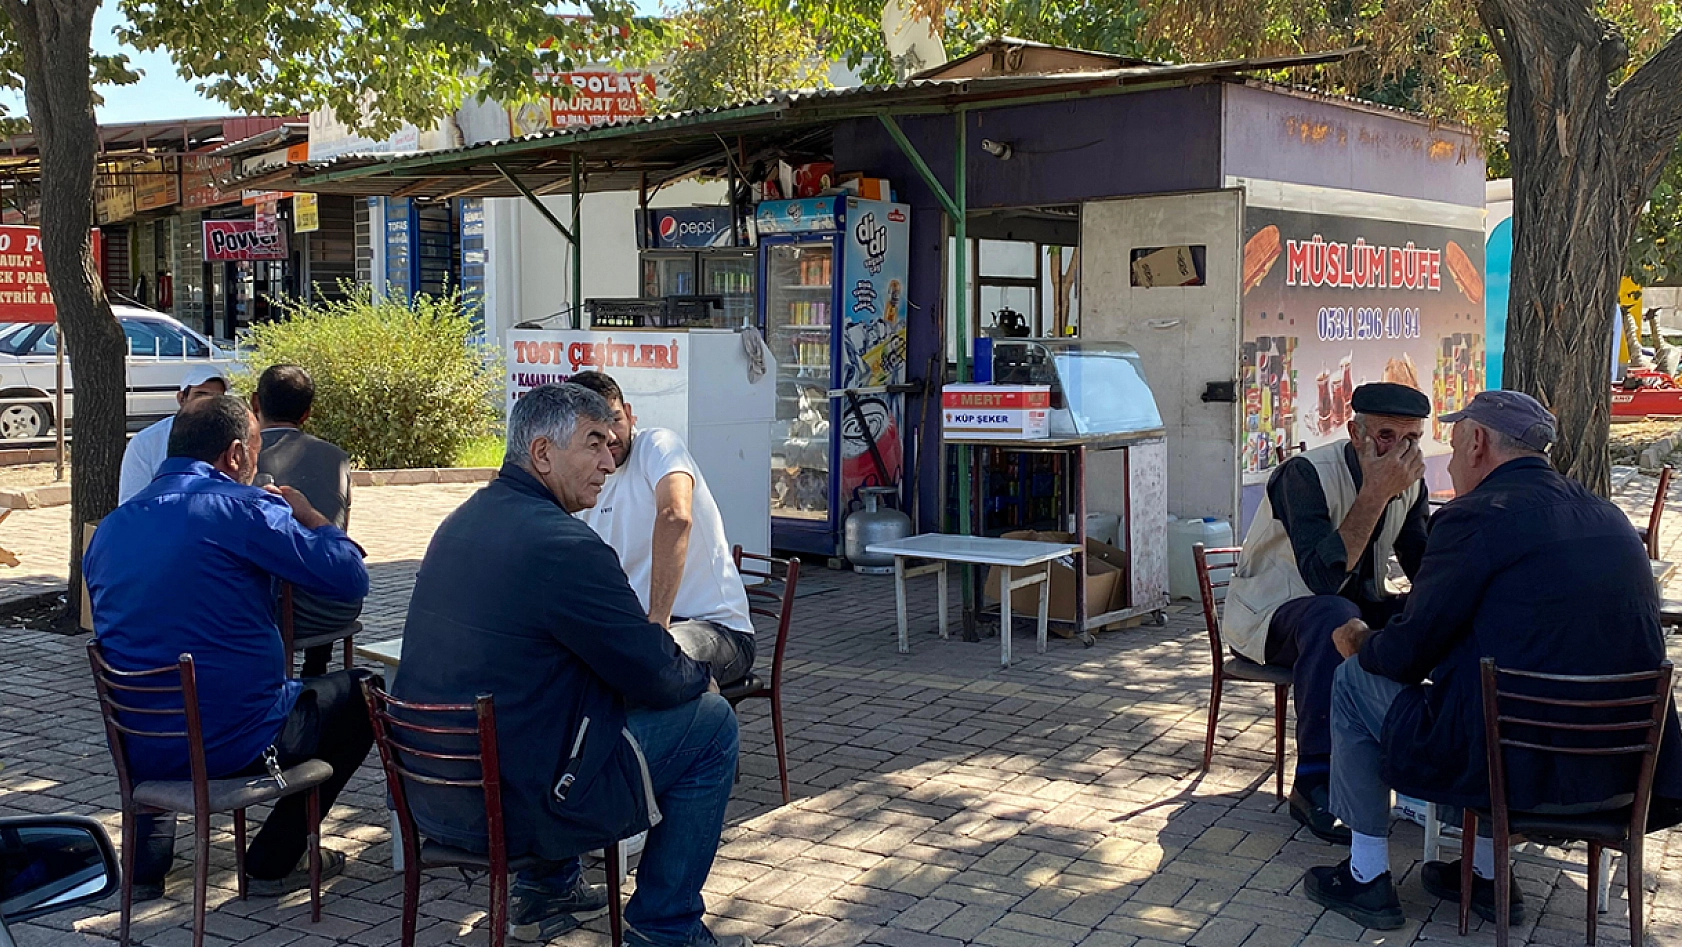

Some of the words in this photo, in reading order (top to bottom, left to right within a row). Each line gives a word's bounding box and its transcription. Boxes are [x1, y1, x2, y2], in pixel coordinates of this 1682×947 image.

[552, 97, 613, 112] MURAT
[679, 218, 715, 237] pepsi
[1286, 234, 1387, 289] MÜSLÜM
[1389, 241, 1441, 291] BÜFE
[1318, 307, 1354, 341] 0534
[1356, 307, 1382, 340] 296
[1385, 307, 1401, 339] 40
[1404, 307, 1421, 339] 94
[513, 340, 563, 364] TOST
[567, 336, 679, 372] ÇEŞİTLERİ
[961, 394, 1003, 405] MERT
[955, 413, 975, 423] KÜP
[977, 414, 1009, 425] ŞEKER
